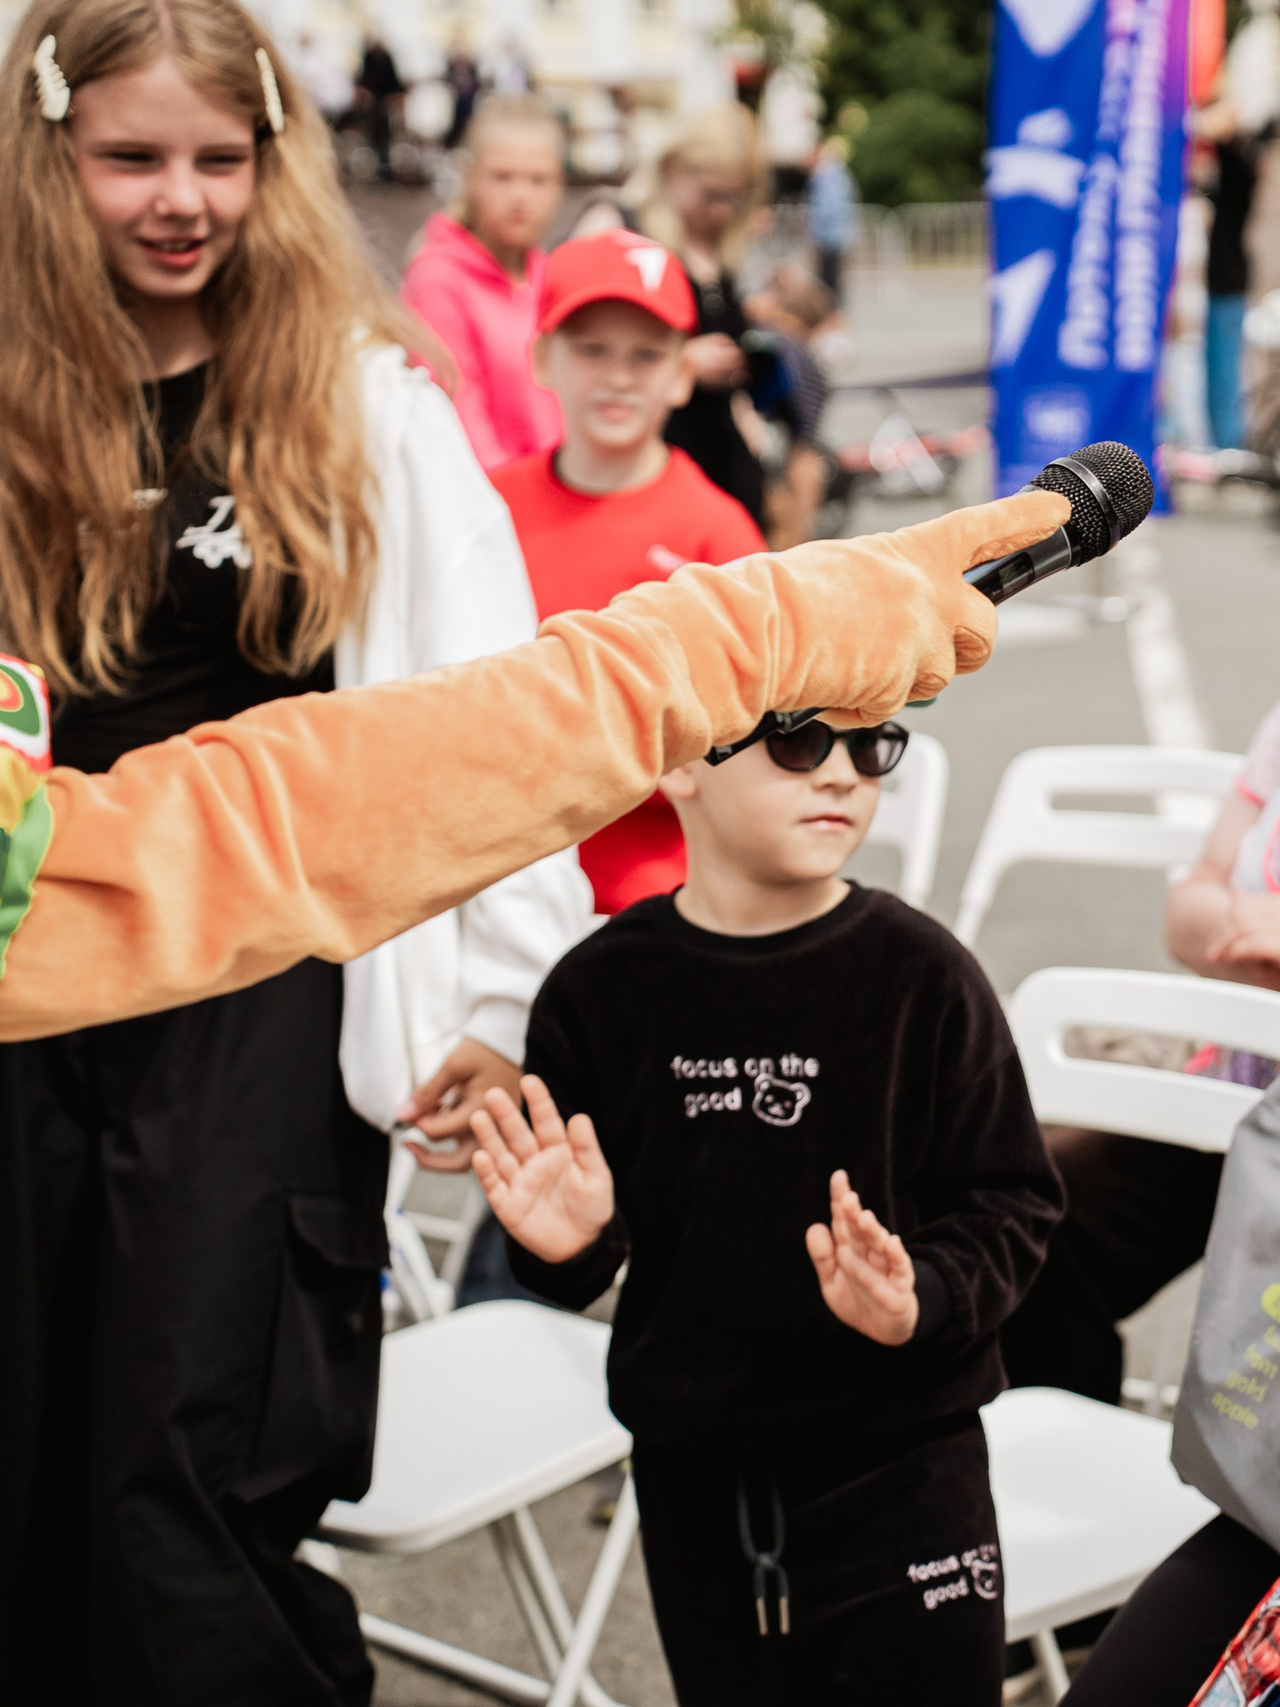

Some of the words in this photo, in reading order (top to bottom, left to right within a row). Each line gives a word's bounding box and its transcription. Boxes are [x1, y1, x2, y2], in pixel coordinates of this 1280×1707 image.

[670, 1055, 739, 1080] focus
[744, 1057, 775, 1077] on
[779, 1052, 820, 1078] the
[684, 1086, 742, 1118] good
[1211, 1391, 1259, 1430] apple
[906, 1554, 960, 1583] focus
[923, 1575, 970, 1610] good
